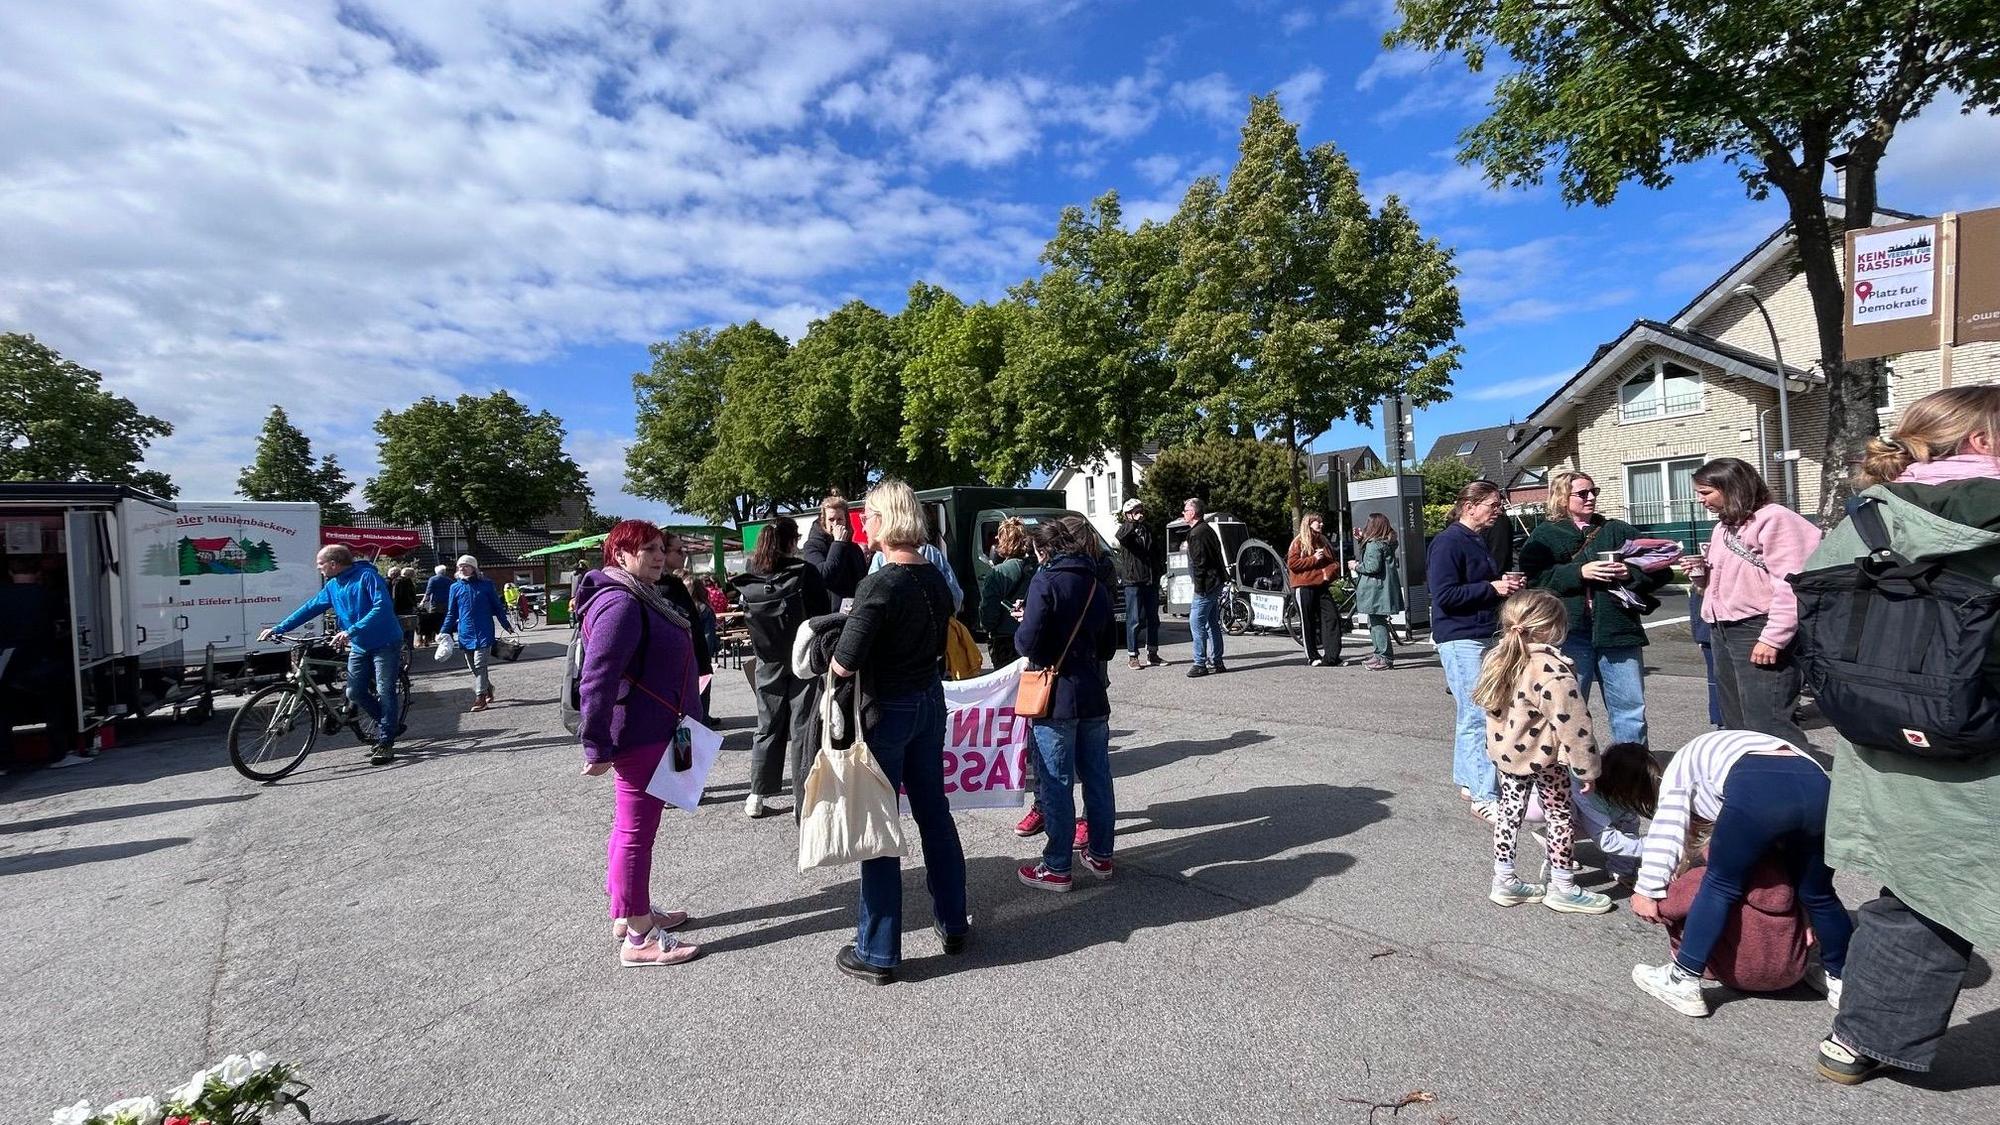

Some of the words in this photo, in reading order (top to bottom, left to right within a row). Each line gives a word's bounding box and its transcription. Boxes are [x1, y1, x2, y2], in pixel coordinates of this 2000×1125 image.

[1857, 251, 1886, 263] KEIN
[1857, 253, 1931, 273] RASSISMUS
[1868, 289, 1898, 299] Platz
[1858, 297, 1928, 314] Demokratie
[198, 597, 232, 606] Eifeler
[234, 595, 282, 604] Landbrot
